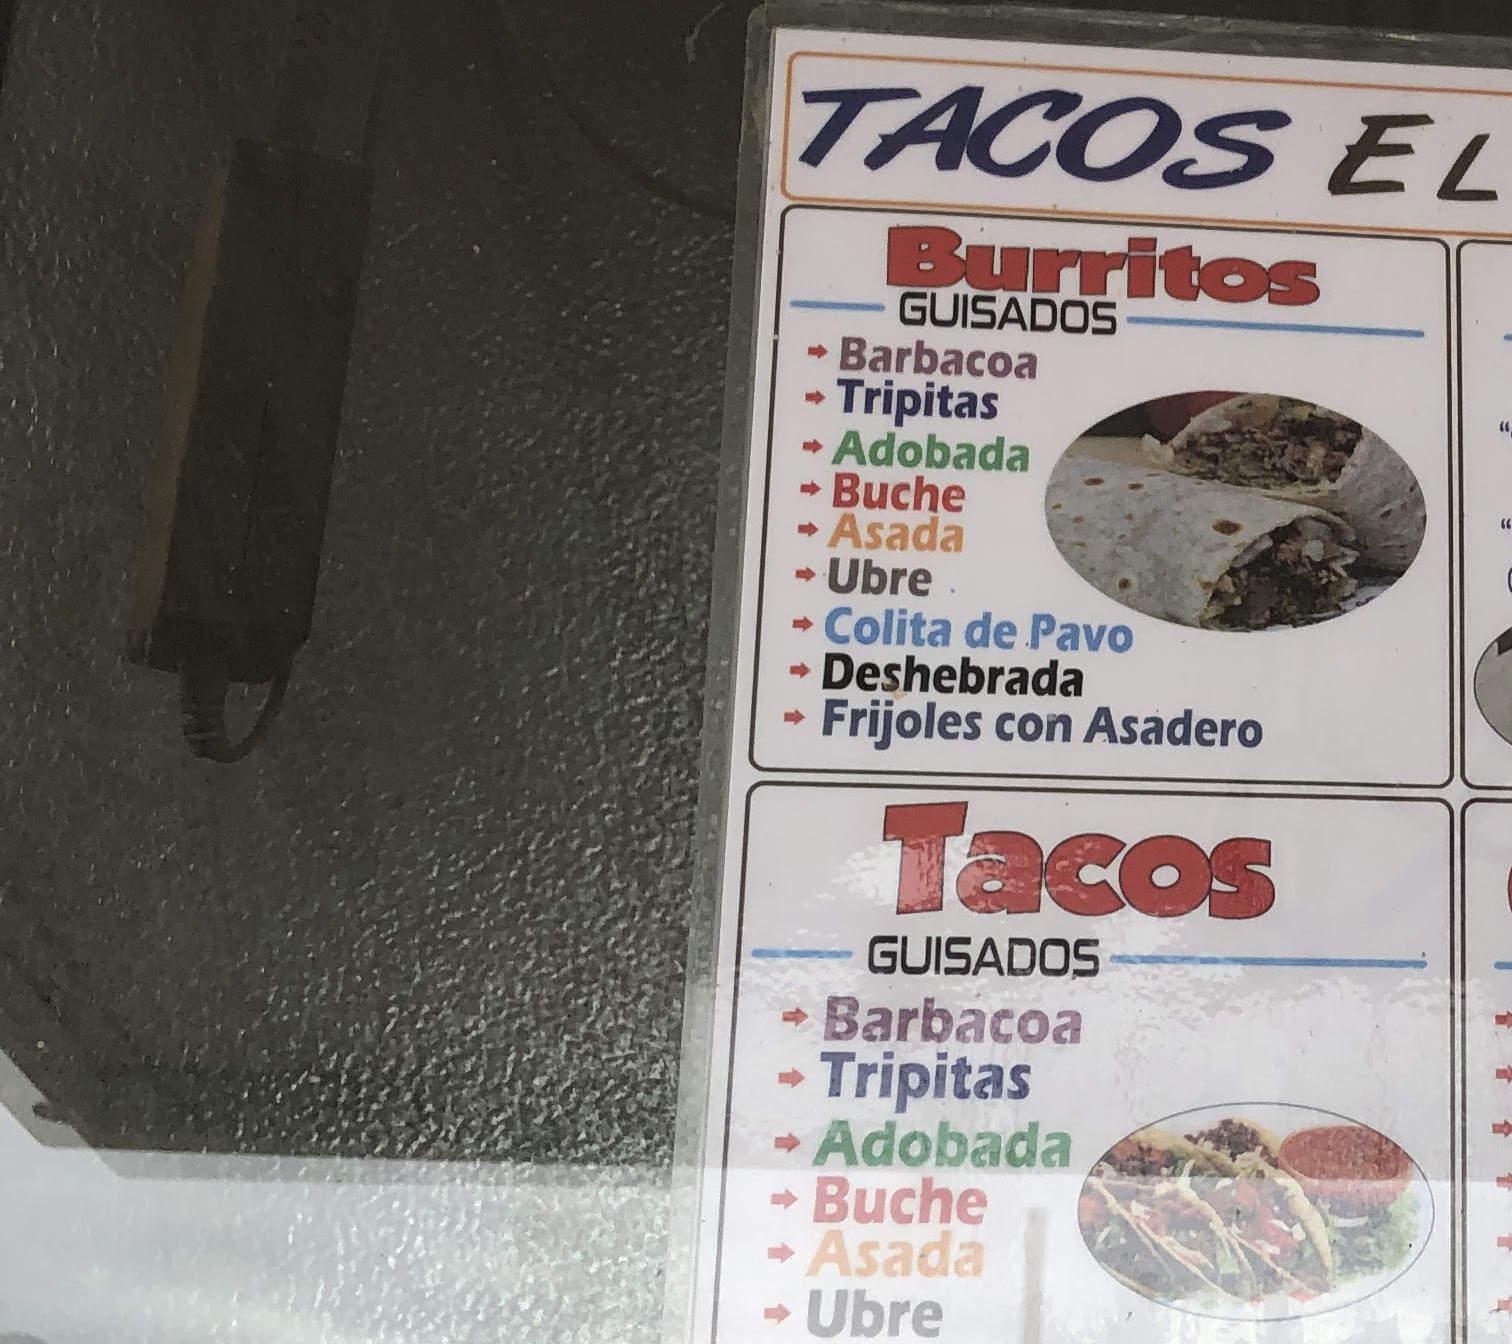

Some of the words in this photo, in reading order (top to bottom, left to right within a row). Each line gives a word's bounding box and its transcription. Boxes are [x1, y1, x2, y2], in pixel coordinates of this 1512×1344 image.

[799, 85, 1293, 191] TACOS
[1326, 113, 1499, 203] EL
[886, 225, 1321, 307] Burritos
[899, 292, 1118, 335] GUISADOS
[838, 336, 1038, 380] Barbacoa
[836, 378, 999, 427] Tripitas
[831, 430, 1030, 473] Adobada
[832, 474, 965, 513] Buche
[827, 515, 965, 553] Asada
[827, 558, 932, 596] Ubre
[824, 606, 951, 649] Colita
[964, 609, 1018, 649] de
[1031, 613, 1134, 654] Pavo
[822, 652, 1084, 697] Deshebrada
[822, 699, 982, 749] Frijoles
[995, 711, 1073, 743] con
[1083, 706, 1264, 749] Asadero
[883, 801, 1275, 921] Tacos
[867, 935, 1099, 978] GUISADOS
[822, 996, 1082, 1046] Barbacoa
[820, 1051, 1031, 1114] Tripitas
[812, 1118, 1072, 1169] Adobada
[812, 1175, 988, 1226] Buche
[806, 1231, 985, 1279] Asada
[805, 1290, 943, 1340] Ubre
